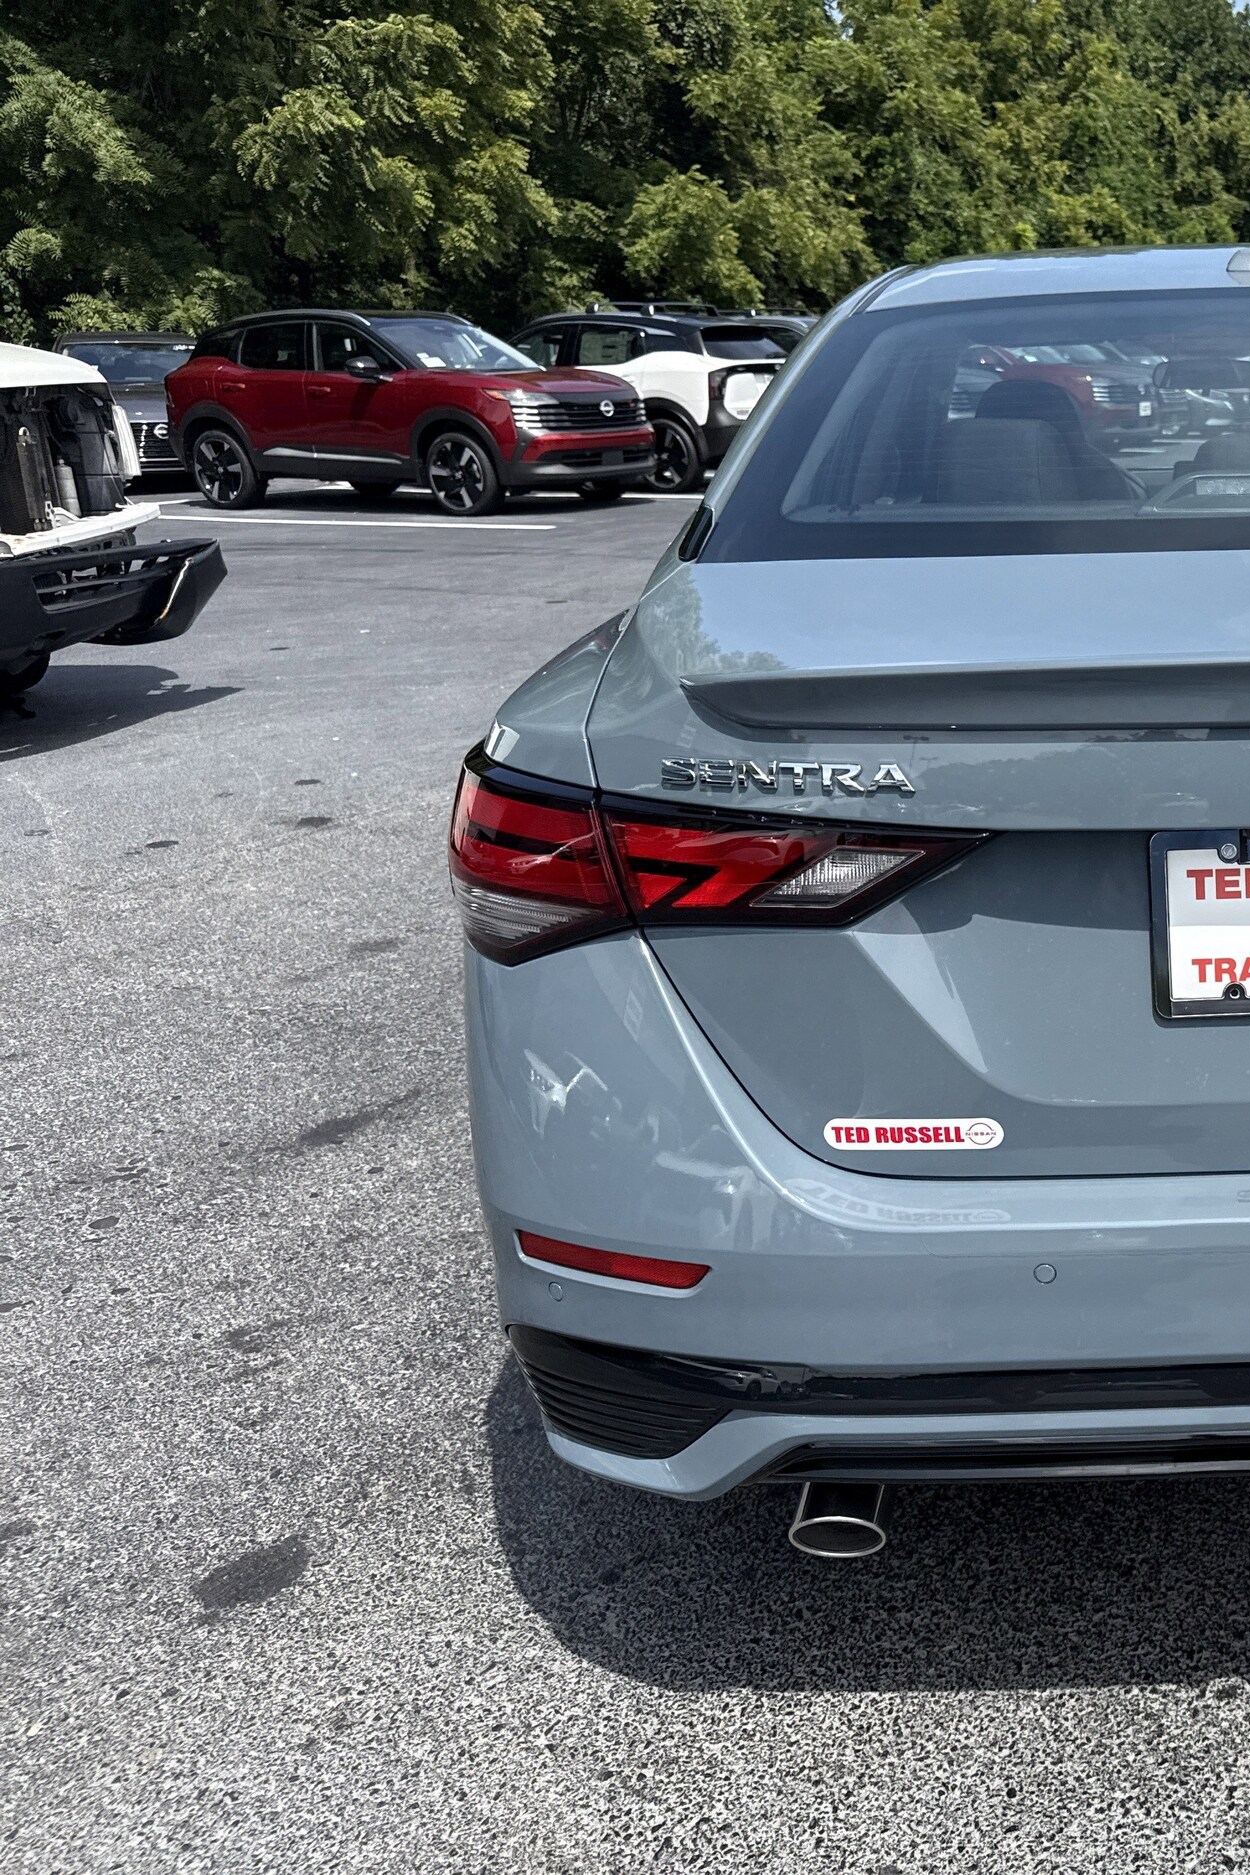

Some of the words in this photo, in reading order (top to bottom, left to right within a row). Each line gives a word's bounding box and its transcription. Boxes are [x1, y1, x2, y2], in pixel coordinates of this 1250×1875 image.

[661, 757, 916, 793] SENTRA
[831, 1126, 870, 1143] TED
[875, 1126, 965, 1143] RUSSELL
